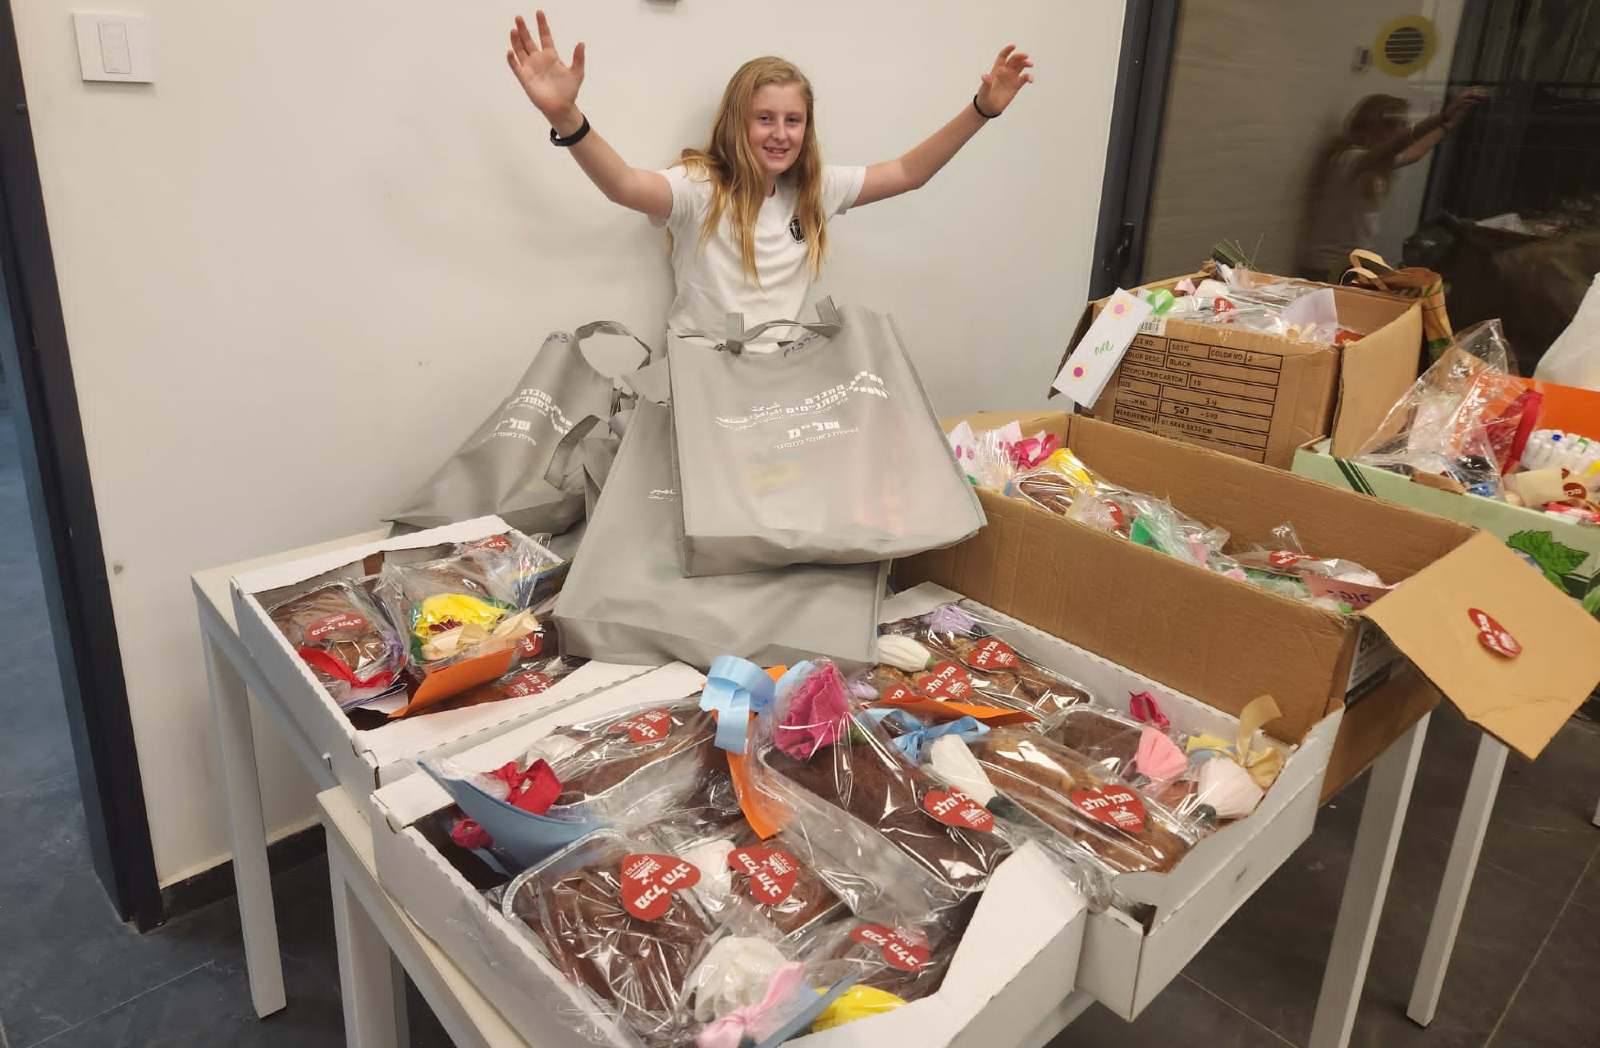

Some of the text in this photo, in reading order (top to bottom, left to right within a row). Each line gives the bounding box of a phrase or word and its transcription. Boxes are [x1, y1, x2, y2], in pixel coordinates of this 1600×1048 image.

[983, 641, 1000, 654] מכל
[926, 665, 957, 693] מכל הלב
[932, 796, 960, 816] הלב
[1081, 792, 1135, 811] מכל הלב
[634, 862, 691, 910] מכל הלב
[737, 852, 783, 898] מכל הלב
[861, 929, 889, 946] מכל
[889, 942, 920, 967] הלב
